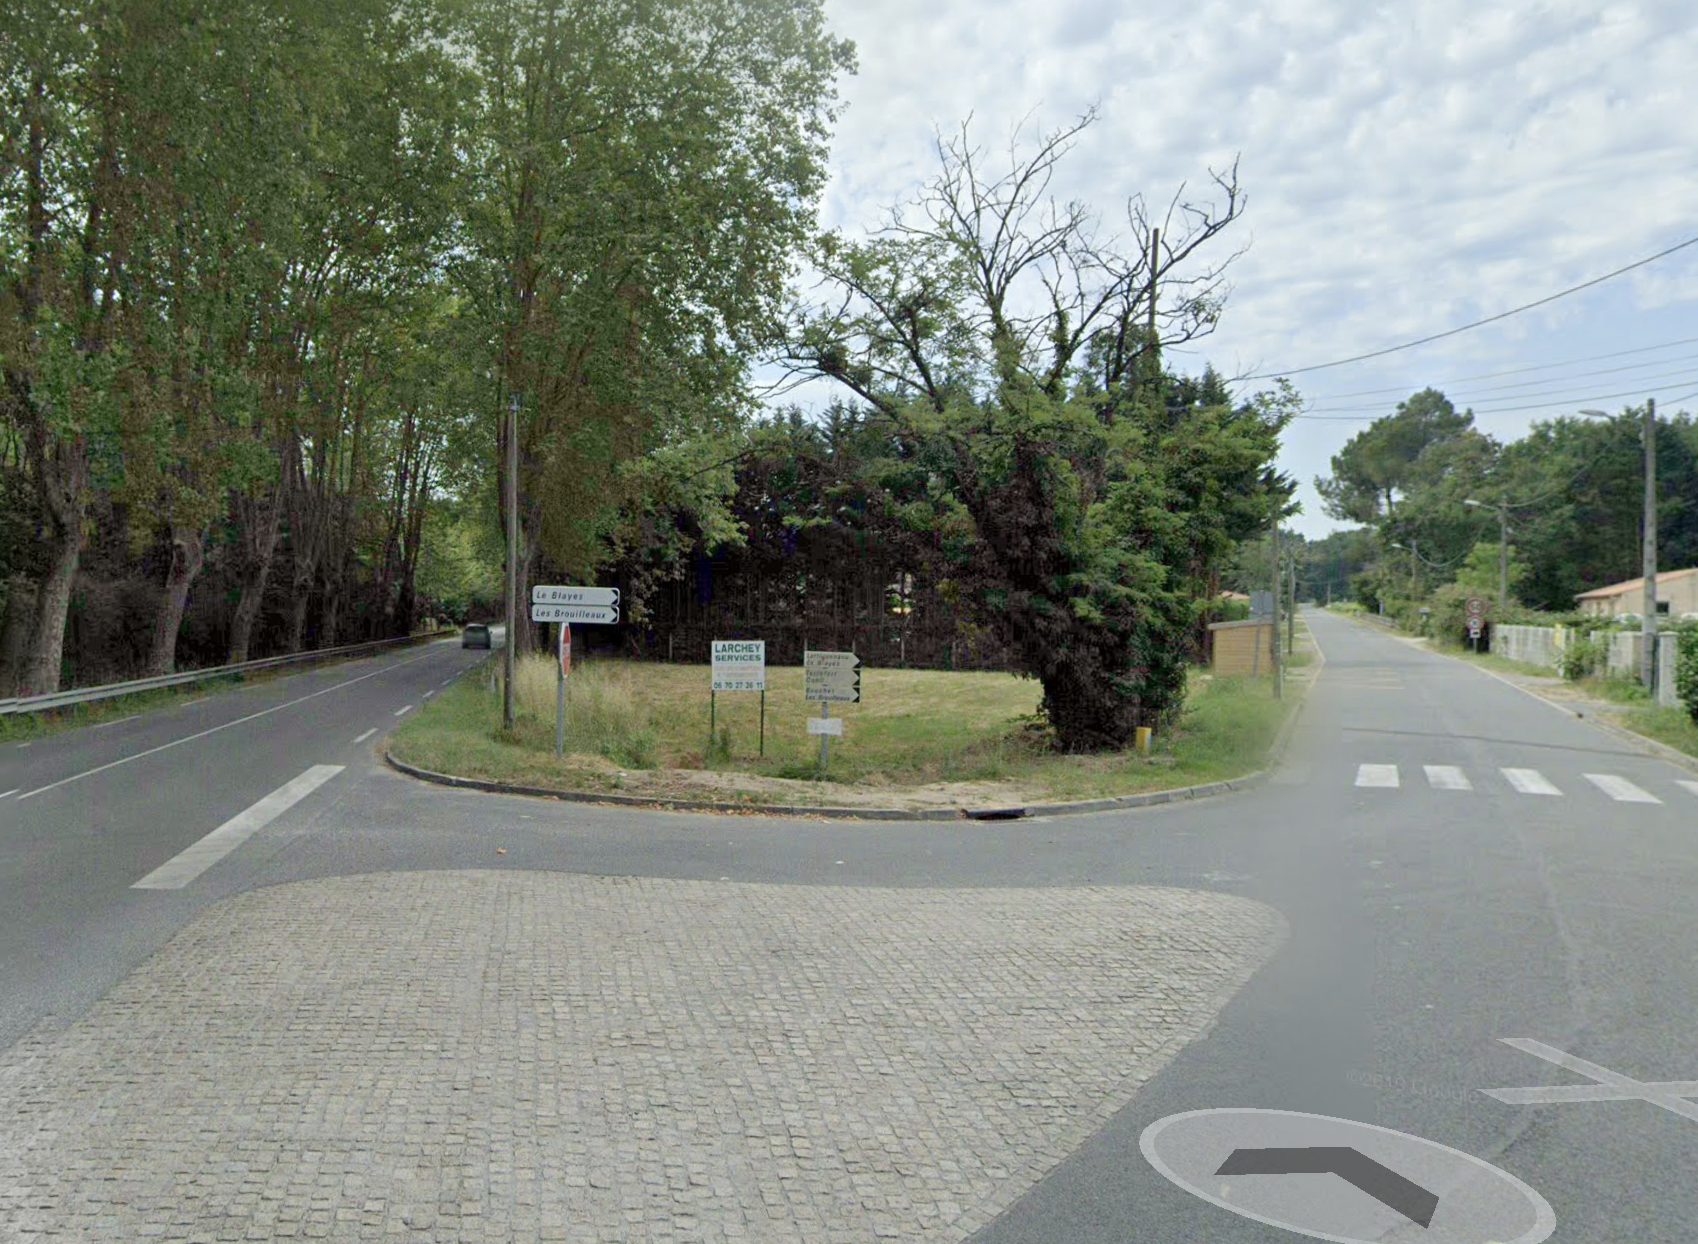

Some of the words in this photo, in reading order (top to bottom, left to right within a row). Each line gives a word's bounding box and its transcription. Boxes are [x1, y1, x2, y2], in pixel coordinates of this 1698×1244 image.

[536, 590, 547, 599] Le
[551, 591, 584, 601] Blayes
[535, 609, 550, 617] Les
[555, 610, 606, 619] Brouilleaux
[715, 643, 761, 653] LARCHEY
